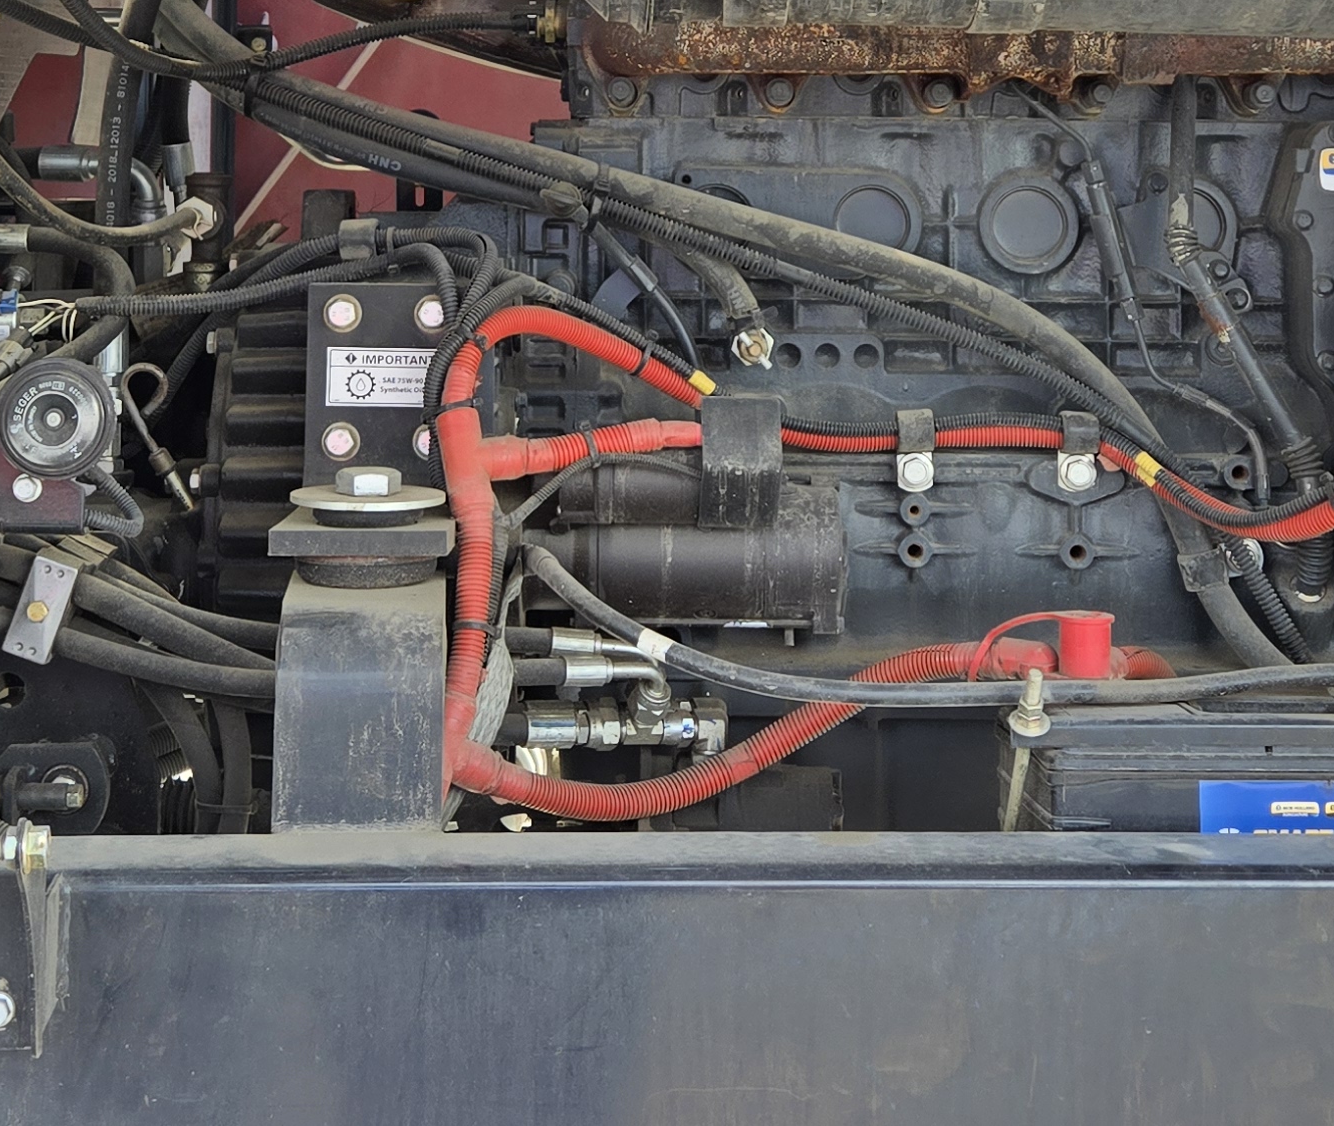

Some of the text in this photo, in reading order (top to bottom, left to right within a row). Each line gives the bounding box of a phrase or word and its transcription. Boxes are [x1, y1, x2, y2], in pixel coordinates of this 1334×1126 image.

[367, 153, 402, 172] CNH
[382, 376, 396, 384] SAE
[380, 386, 412, 394] Synthetic
[13, 386, 39, 422] SEGER
